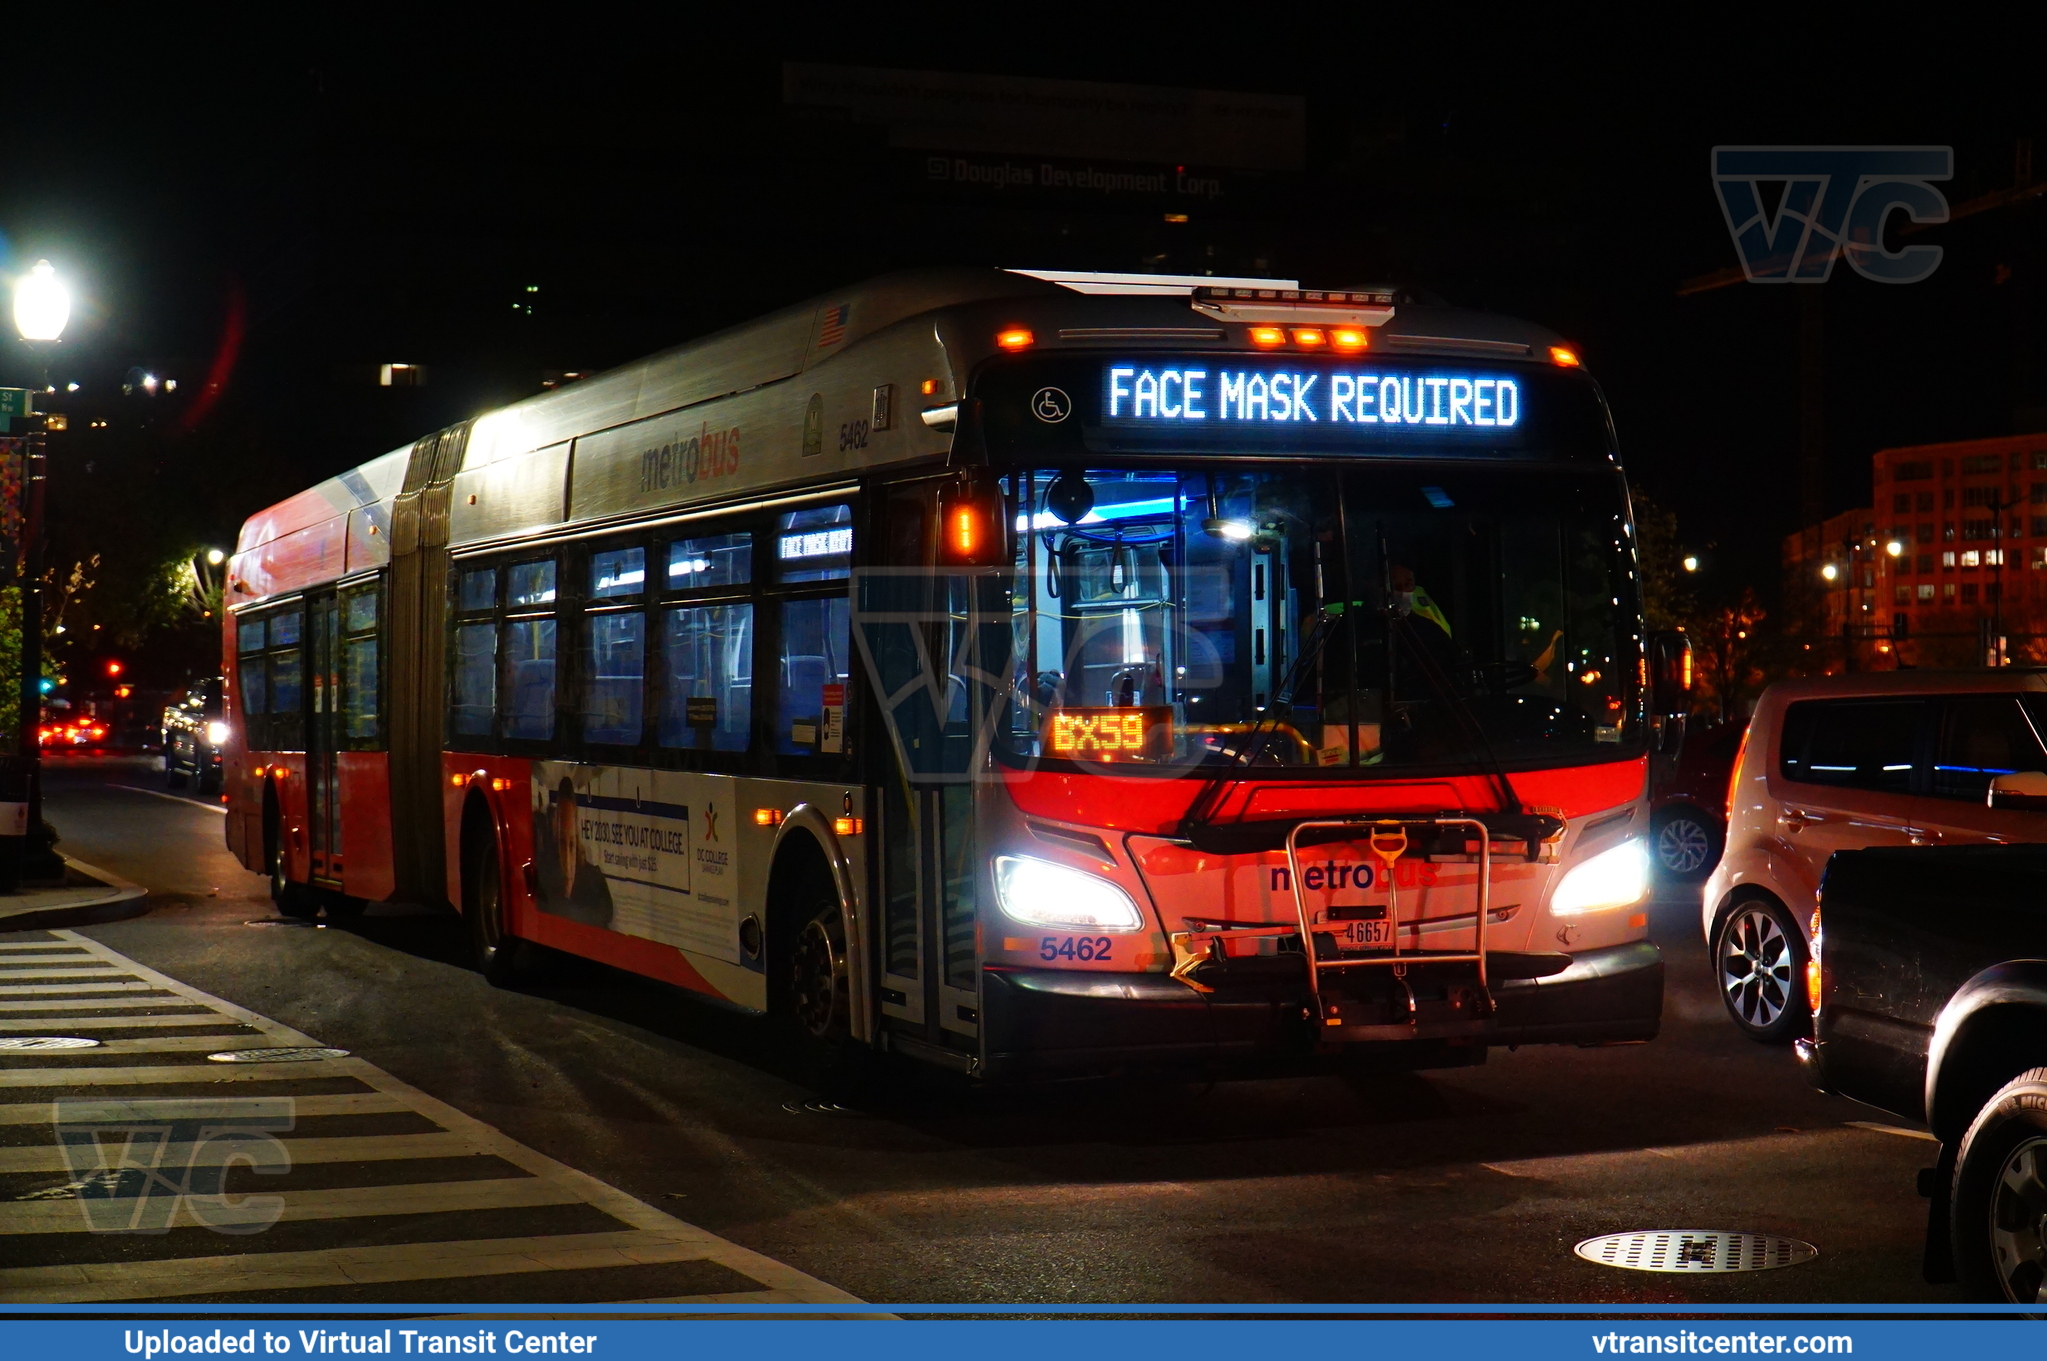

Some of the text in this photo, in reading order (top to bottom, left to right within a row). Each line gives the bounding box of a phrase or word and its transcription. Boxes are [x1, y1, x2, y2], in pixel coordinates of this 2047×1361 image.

[955, 158, 1225, 200] Douglas Development Corp.
[1111, 368, 1518, 426] FACE MASK REQUIRED
[839, 419, 869, 452] 5462
[640, 420, 741, 493] metrobus
[581, 818, 594, 840] HEY
[612, 823, 624, 845] SEE
[624, 824, 639, 847] YOU
[640, 827, 649, 849] AT
[1270, 858, 1438, 892] metrobus
[1040, 936, 1112, 961] 5462
[1346, 921, 1390, 943] 46657
